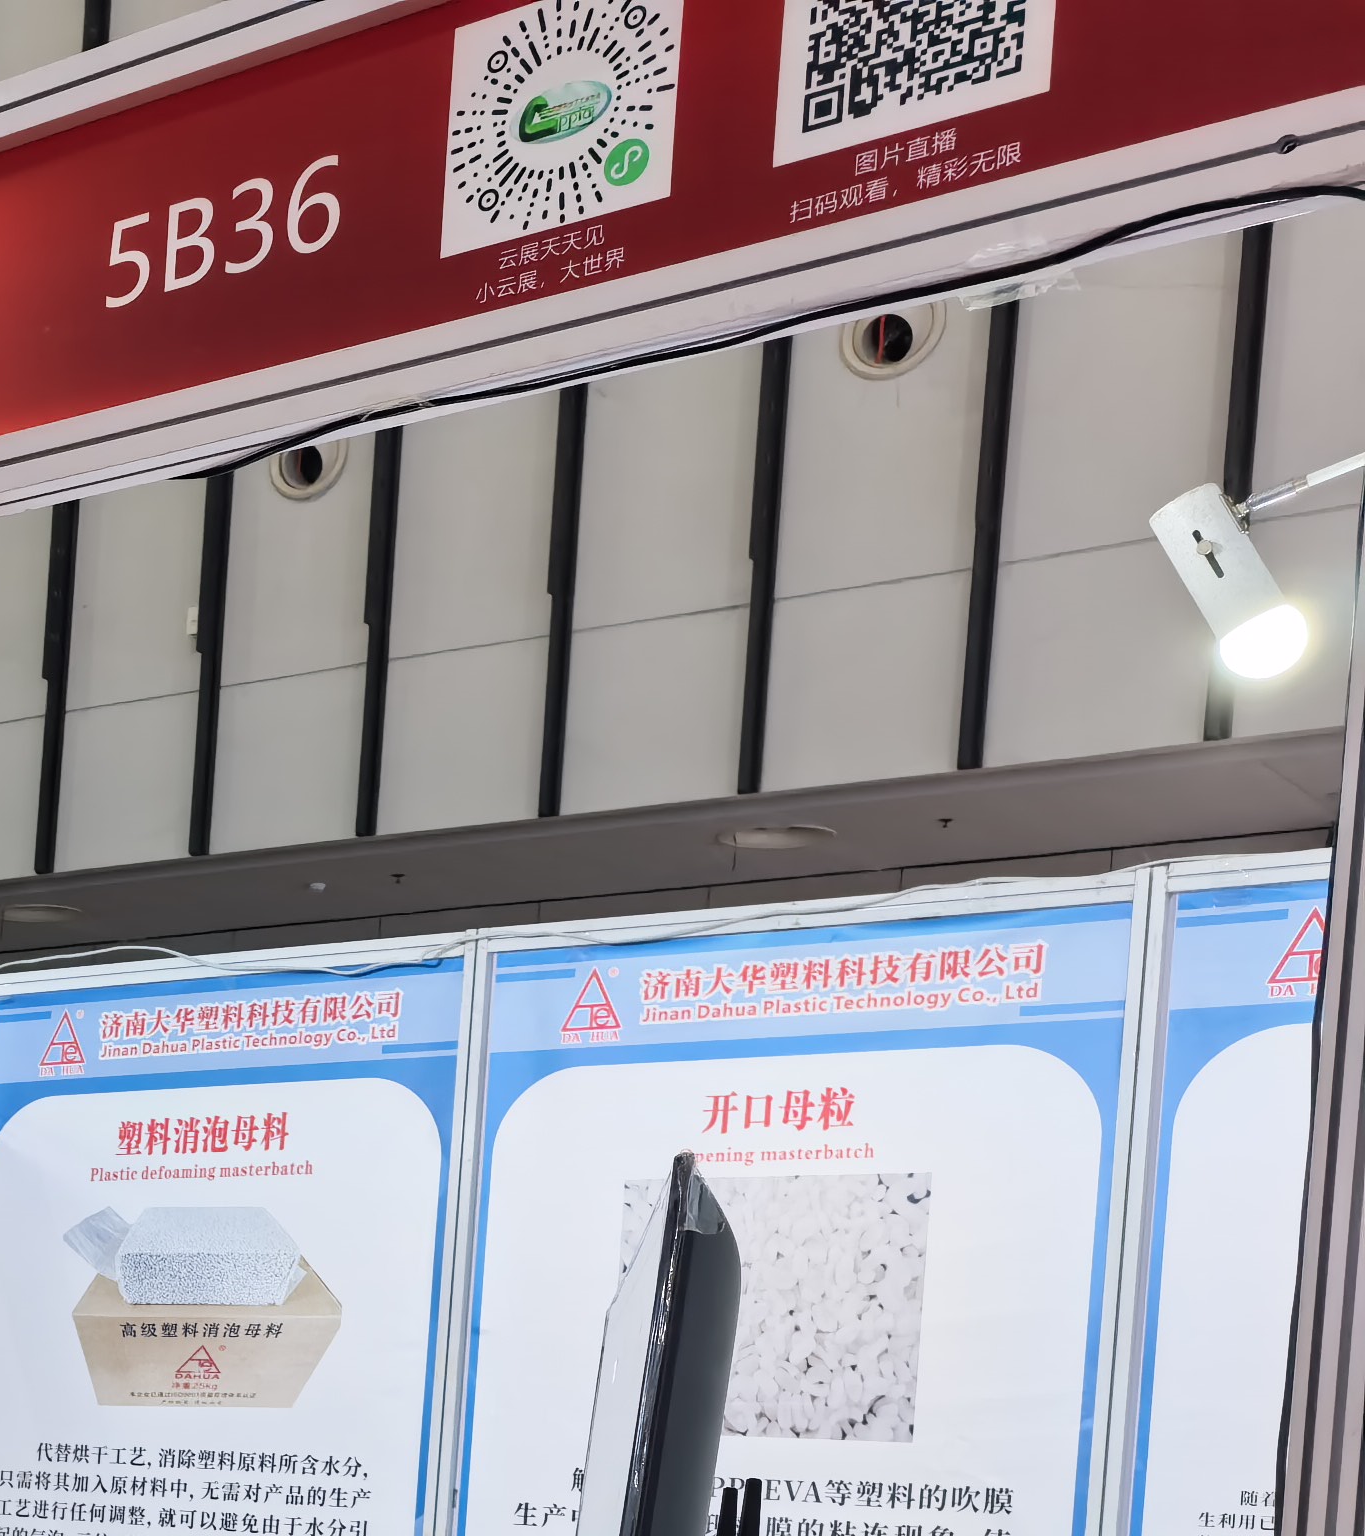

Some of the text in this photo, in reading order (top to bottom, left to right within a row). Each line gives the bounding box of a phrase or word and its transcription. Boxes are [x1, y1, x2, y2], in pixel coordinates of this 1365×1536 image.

[854, 127, 957, 177] 图片直播
[105, 155, 343, 309] 5B36
[498, 225, 605, 270] 云展天天见
[641, 942, 1047, 1001] 济南大华塑料科技有限公司
[1270, 984, 1295, 997] DA
[100, 989, 403, 1040] 济南大华塑料科技有限公司
[642, 981, 1038, 1025] Jinan Dahua Plastic Technology Co., Ltd
[101, 1023, 396, 1060] Jinan Dahua Plastic Technology Co., Ltd
[562, 1030, 620, 1043] DA HUA
[40, 1066, 54, 1076] DA
[701, 1086, 856, 1135] 开口母粒
[115, 1111, 289, 1158] 塑料消泡母料
[761, 1143, 874, 1161] masterbatch
[90, 1160, 313, 1183] Plastic defoaming masterbatch
[119, 1322, 284, 1339] 高级塑料消泡母料
